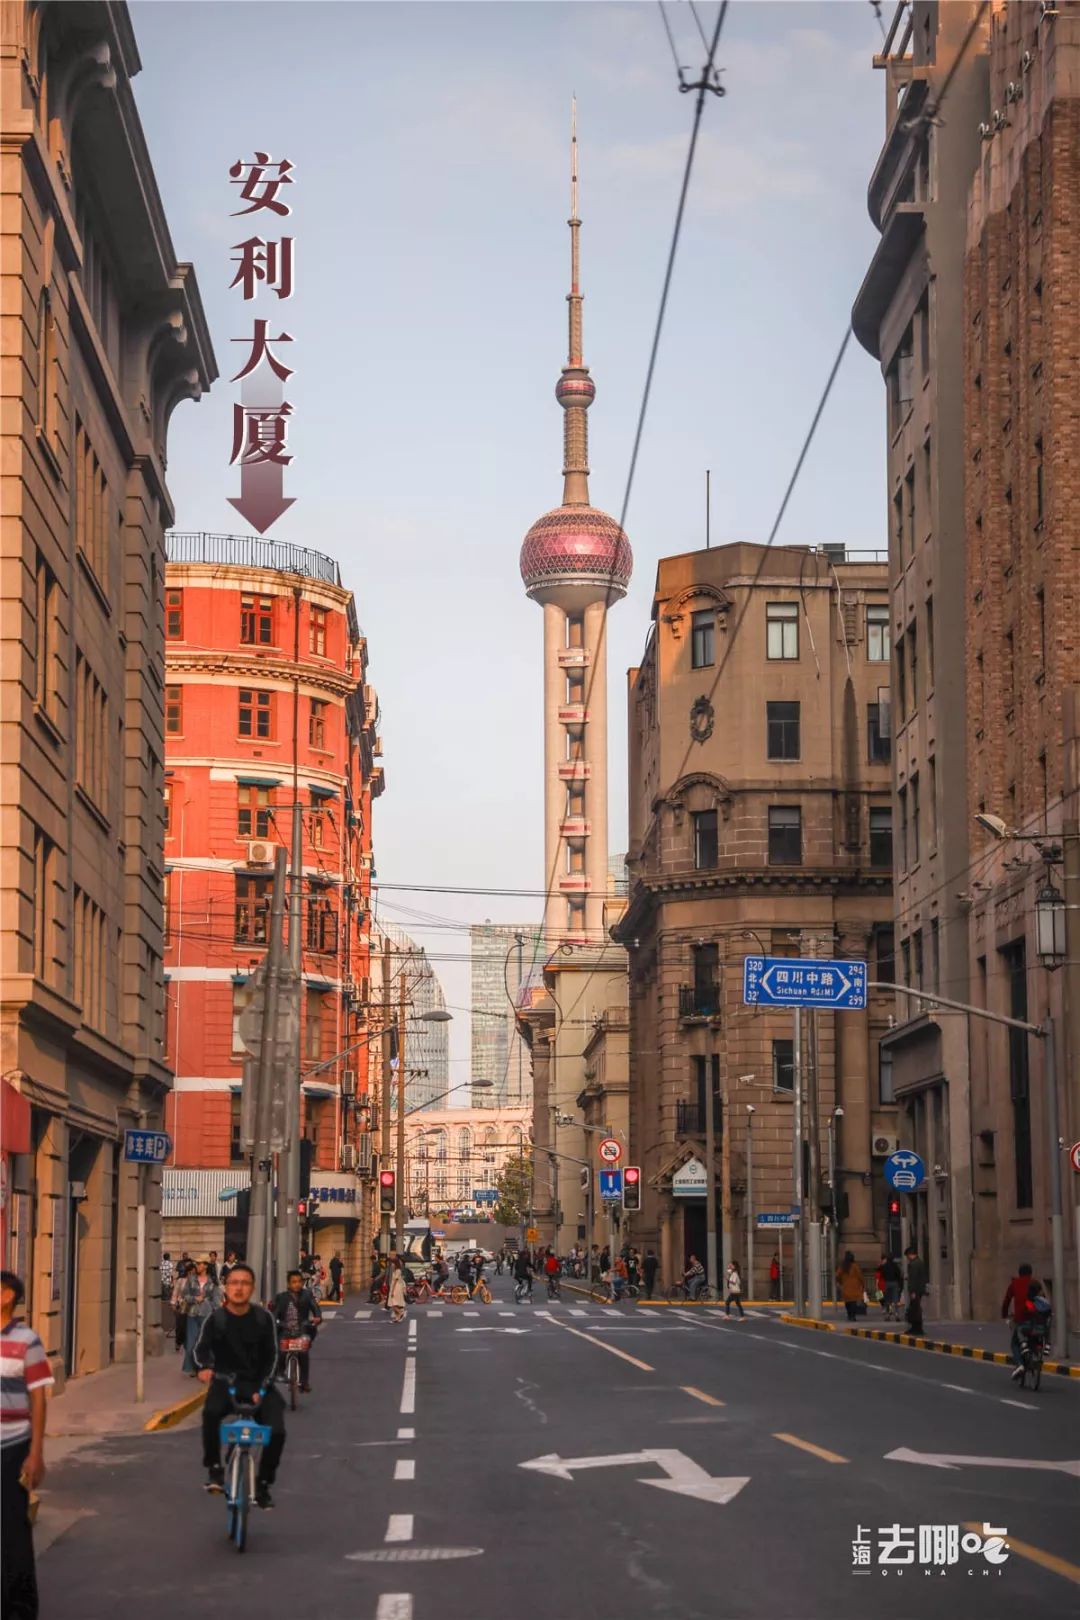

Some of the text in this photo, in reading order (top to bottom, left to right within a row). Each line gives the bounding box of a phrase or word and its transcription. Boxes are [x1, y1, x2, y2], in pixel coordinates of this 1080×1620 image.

[749, 961, 762, 971] 320
[849, 966, 863, 975] 294
[748, 973, 757, 983] 北
[777, 971, 834, 985] 四川中路
[853, 977, 863, 987] 南
[777, 986, 807, 995] Sichuan
[849, 996, 863, 1005] 299
